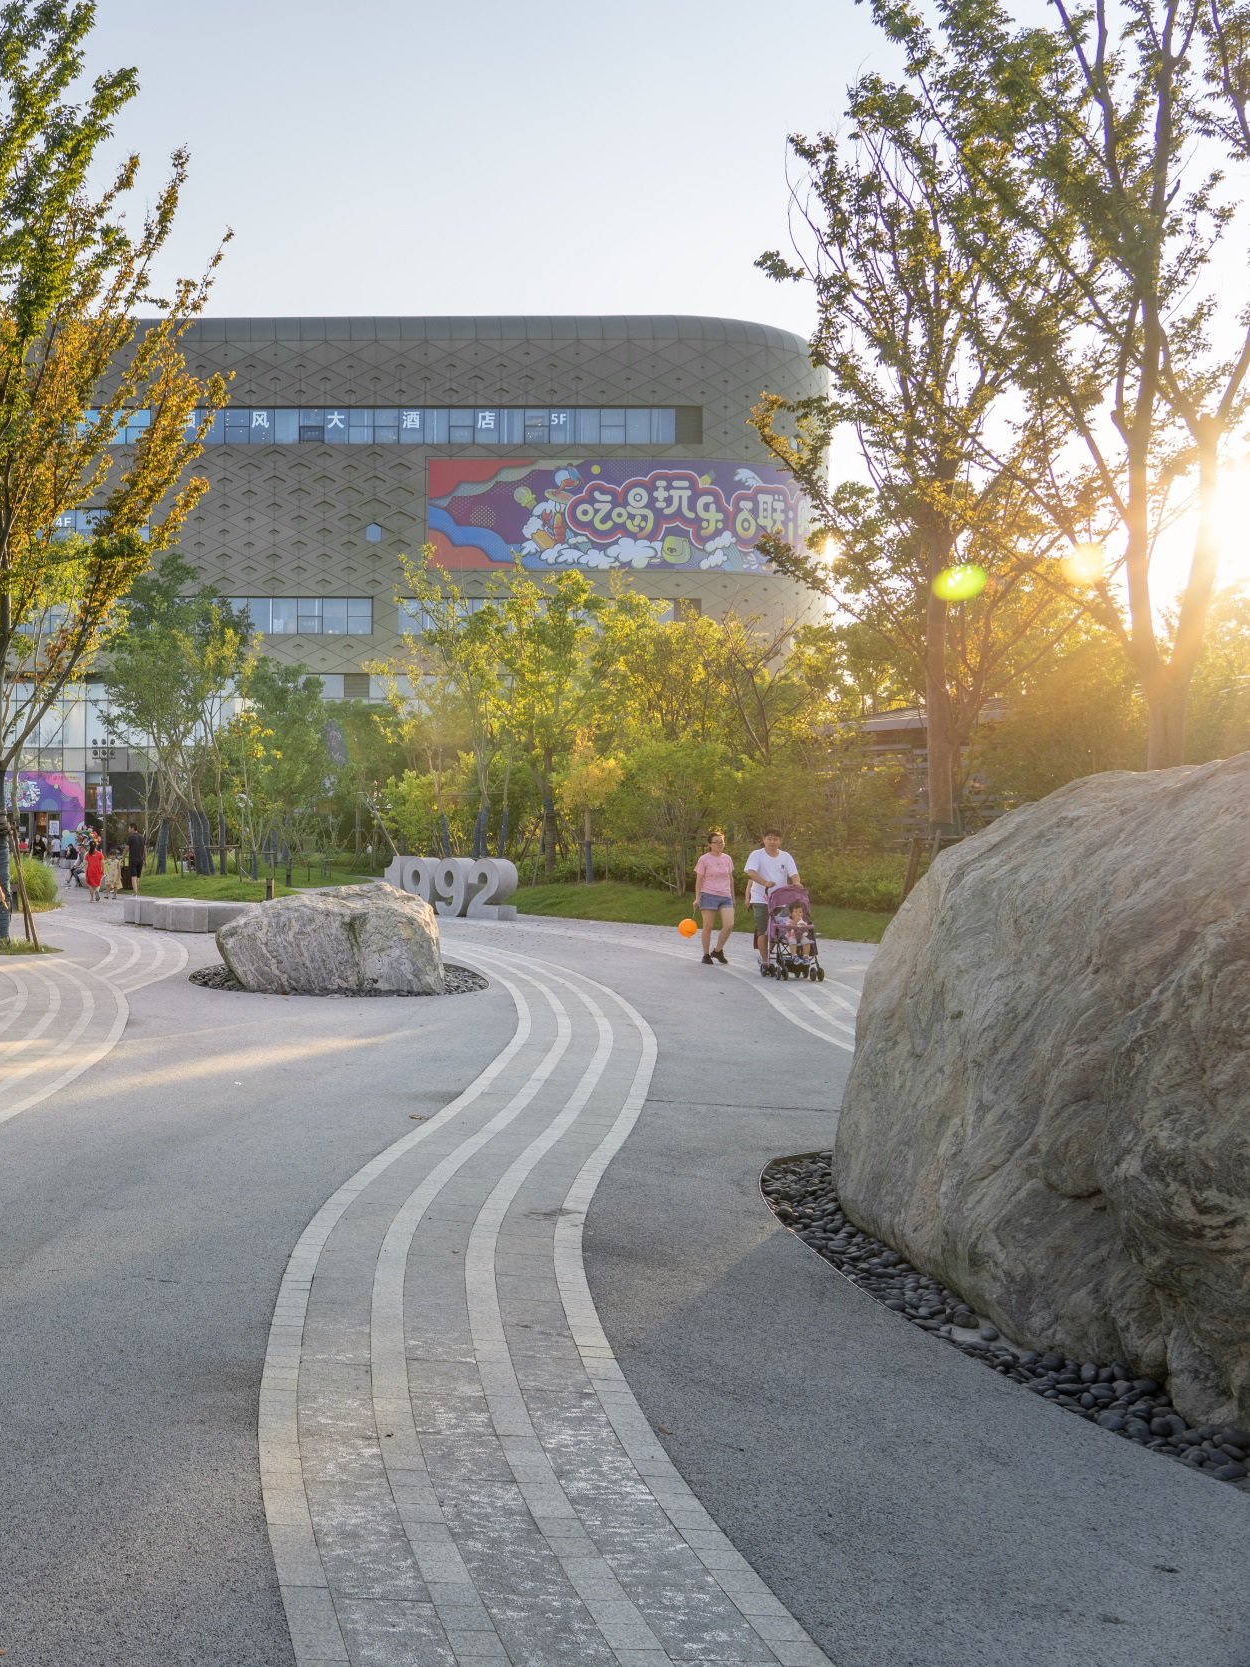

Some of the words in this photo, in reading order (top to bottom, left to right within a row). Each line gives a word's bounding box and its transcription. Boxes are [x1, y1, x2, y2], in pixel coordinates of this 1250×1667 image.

[550, 413, 567, 425] 5F
[55, 517, 72, 527] 4F
[384, 855, 518, 920] 1992
